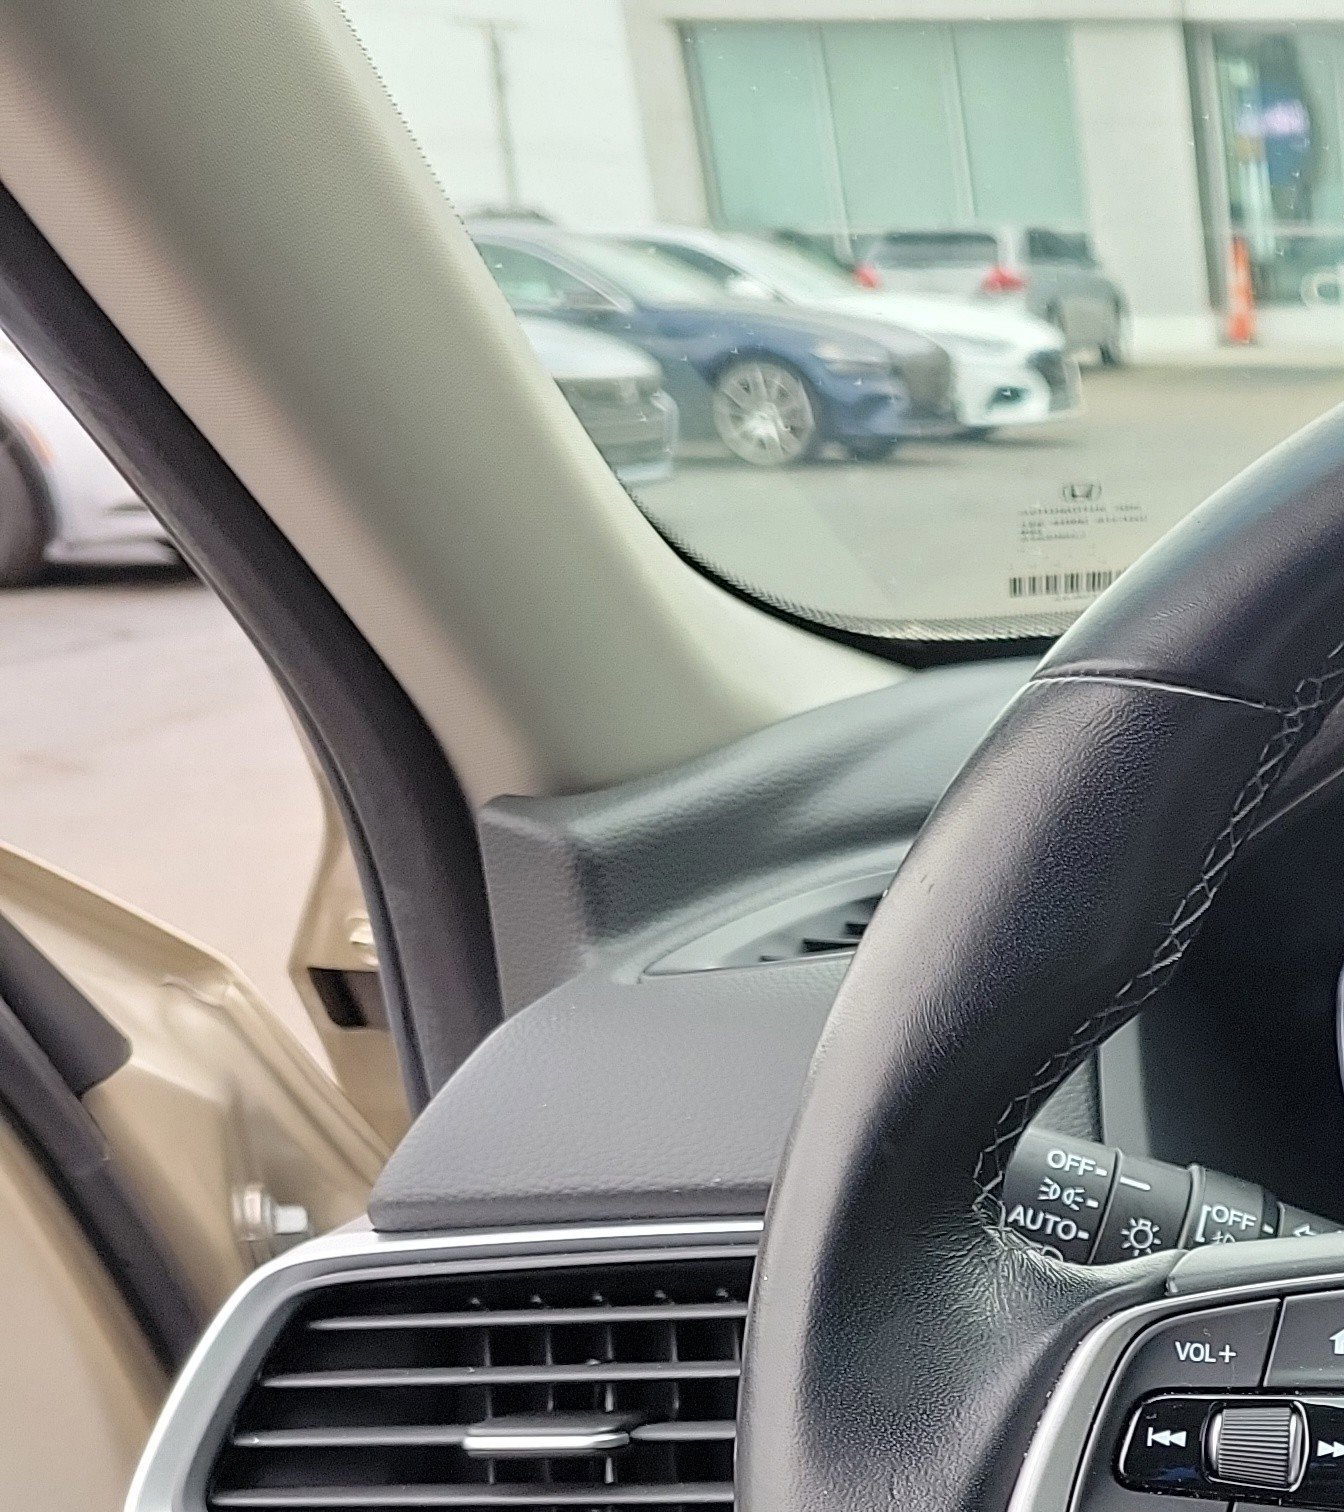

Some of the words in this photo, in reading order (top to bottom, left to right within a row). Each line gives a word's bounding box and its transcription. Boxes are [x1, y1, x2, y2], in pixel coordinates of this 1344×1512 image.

[1046, 1150, 1098, 1177] OFF
[1006, 1204, 1079, 1241] AUTO
[1211, 1204, 1258, 1231] OFF
